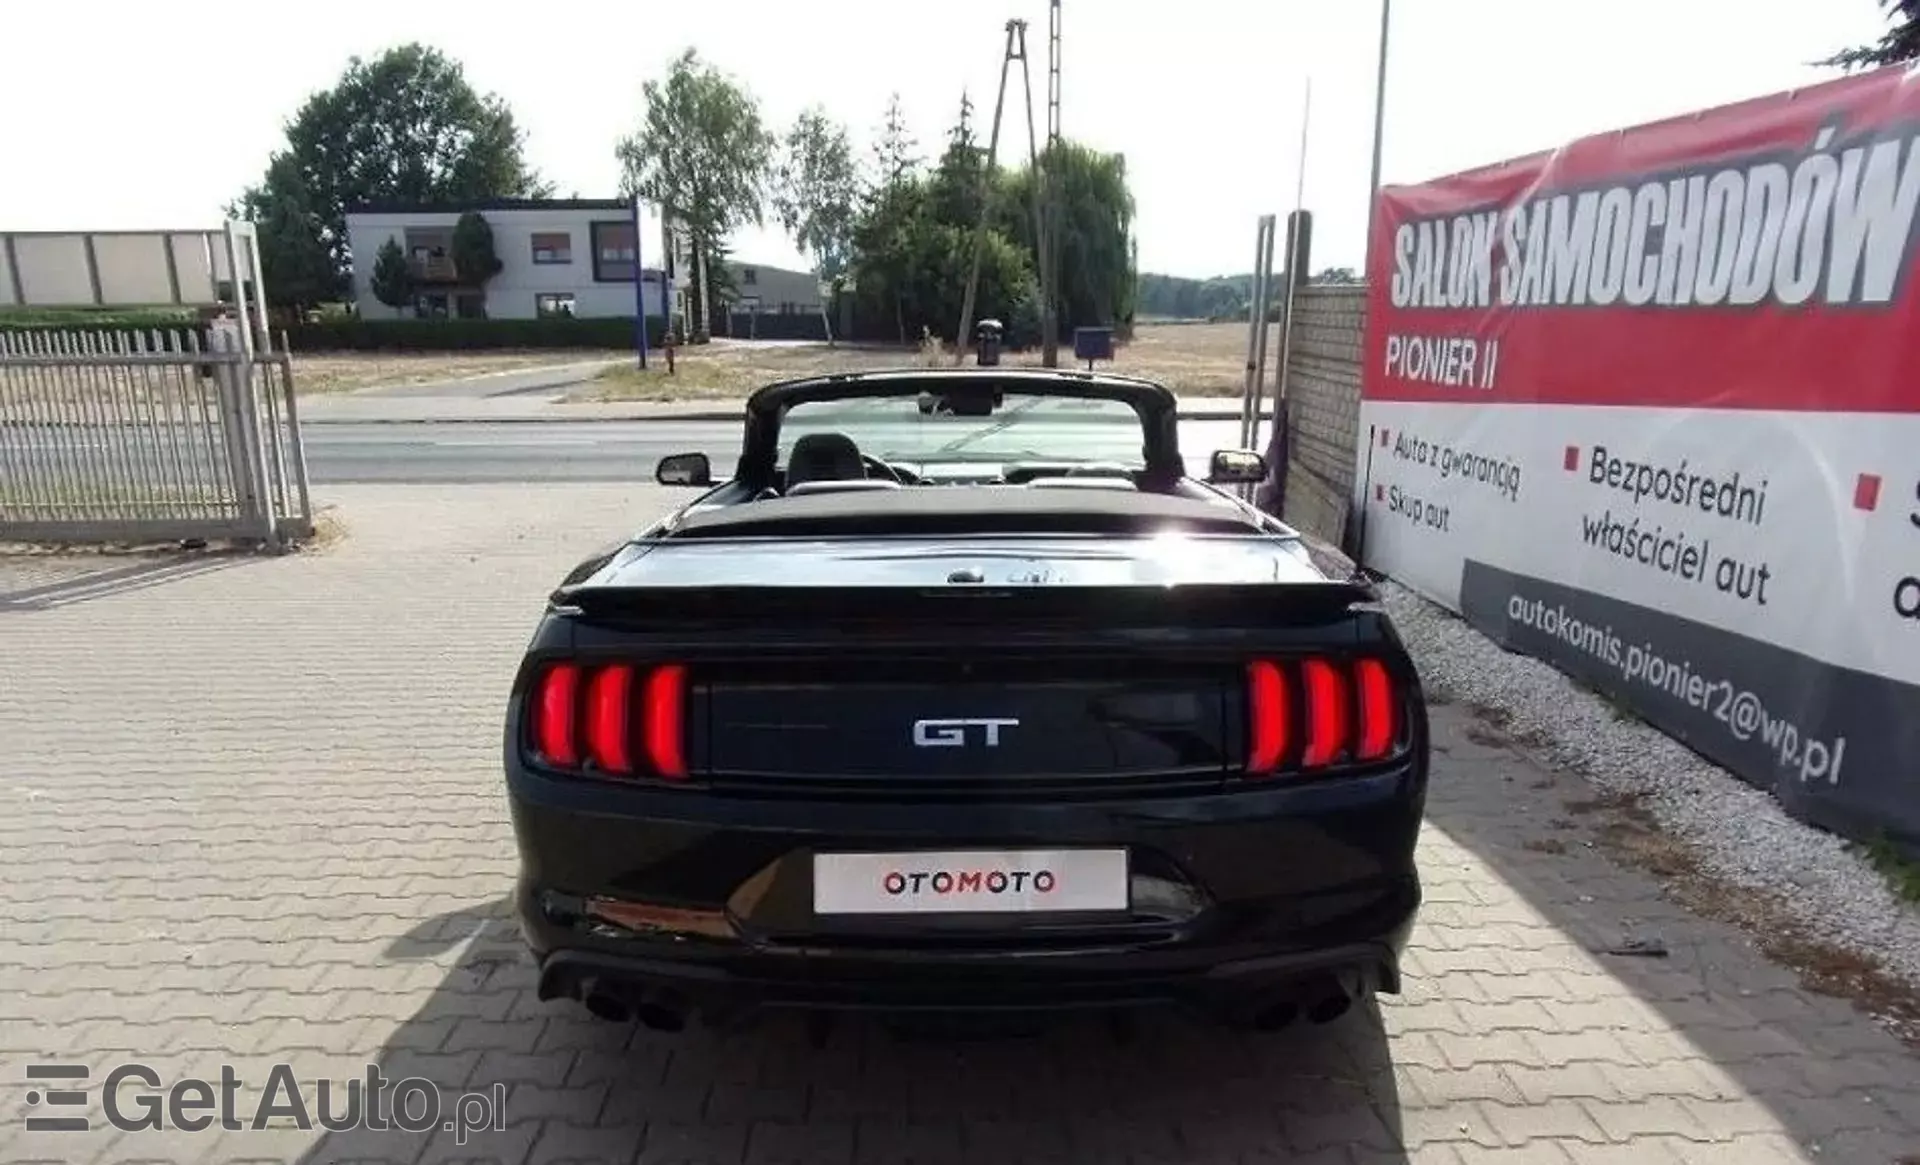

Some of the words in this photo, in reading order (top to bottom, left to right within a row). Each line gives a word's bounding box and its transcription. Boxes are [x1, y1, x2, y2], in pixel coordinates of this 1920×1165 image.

[1391, 210, 1498, 308] SALON
[1500, 127, 1920, 305] SAMOCHODÓW
[1384, 335, 1476, 386] PIONIER
[1479, 339, 1499, 390] II
[1393, 431, 1428, 463] Auto
[1429, 445, 1439, 467] z
[1441, 448, 1521, 502] gwarancją
[1589, 446, 1768, 526] Bezpośredni
[1388, 485, 1423, 526] Skup
[1425, 503, 1450, 532] aut
[1583, 513, 1708, 583] właściciel
[1716, 552, 1771, 605] aut
[1507, 594, 1846, 785] autokomis.pionier2@wp.pl
[913, 718, 1020, 747] GT
[884, 870, 1056, 894] OTOMOTO
